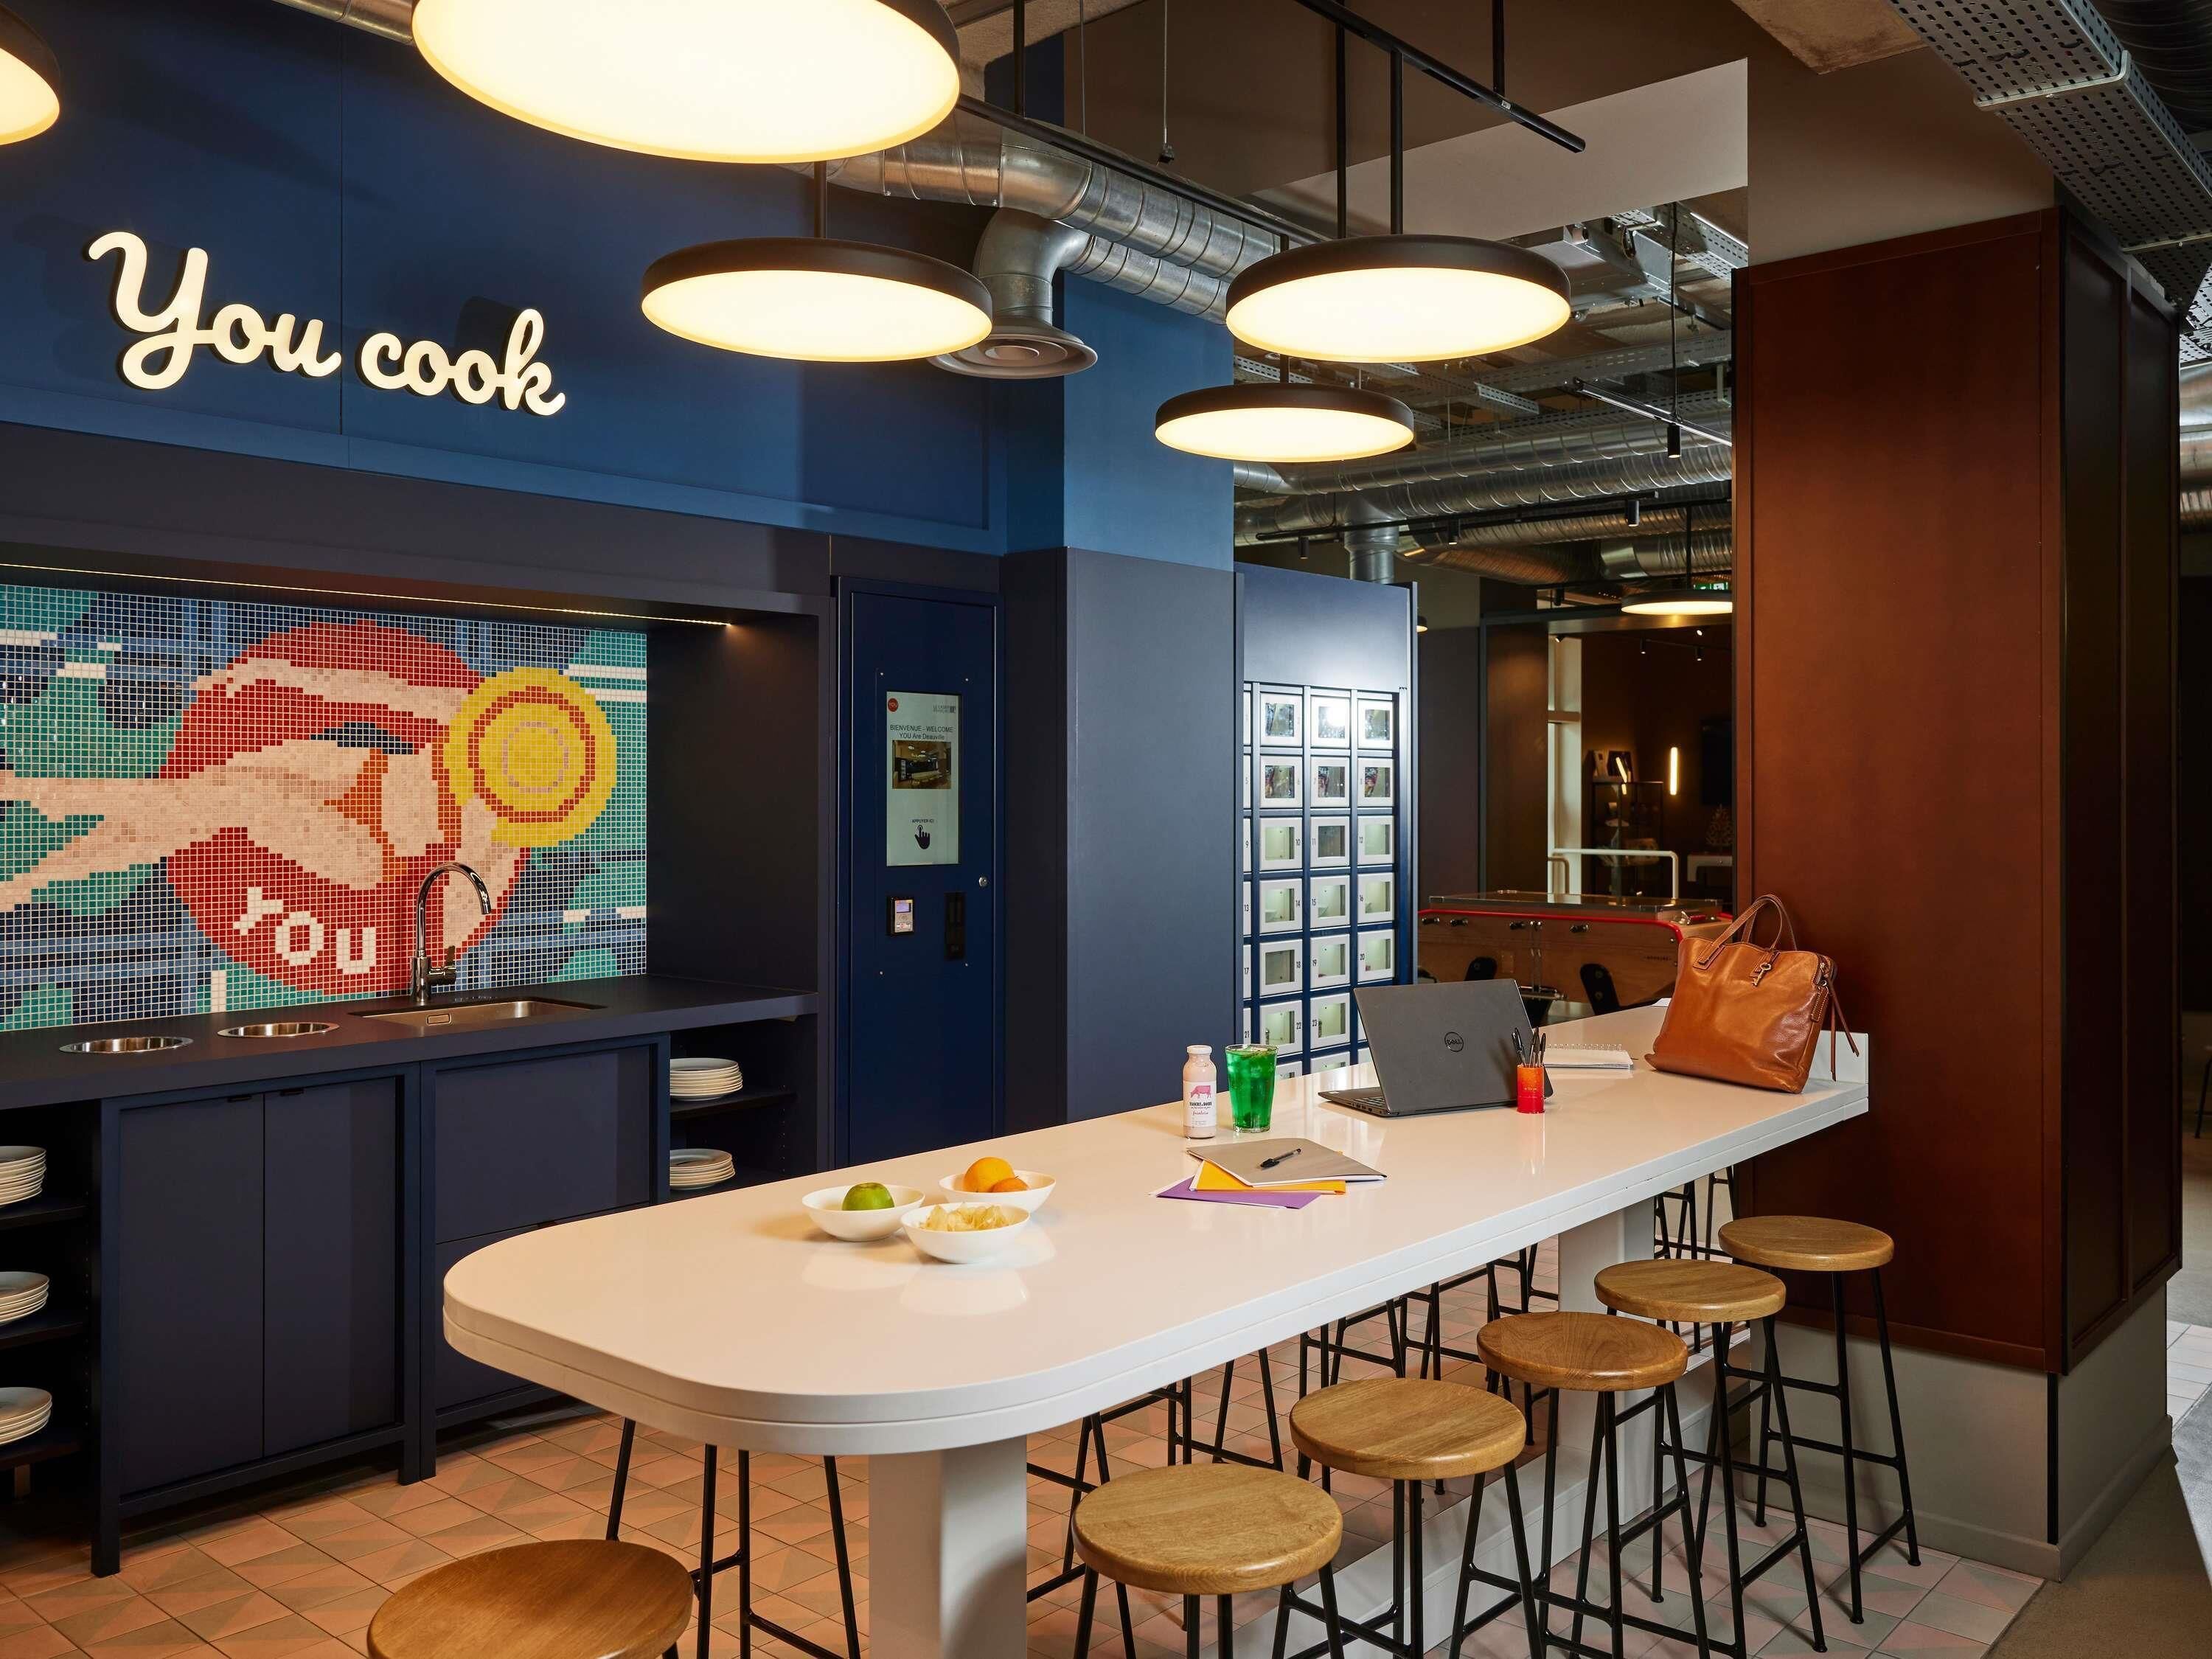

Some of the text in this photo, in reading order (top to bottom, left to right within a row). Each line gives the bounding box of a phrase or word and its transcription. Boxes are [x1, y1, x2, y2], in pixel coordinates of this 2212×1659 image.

[88, 232, 566, 416] You cook
[1245, 840, 1249, 848] 9
[1312, 838, 1316, 846] 11
[1312, 898, 1316, 906] 15
[1244, 904, 1249, 912] 13
[233, 887, 377, 975] YOU
[1244, 967, 1249, 975] 17
[1245, 1031, 1250, 1039] 21
